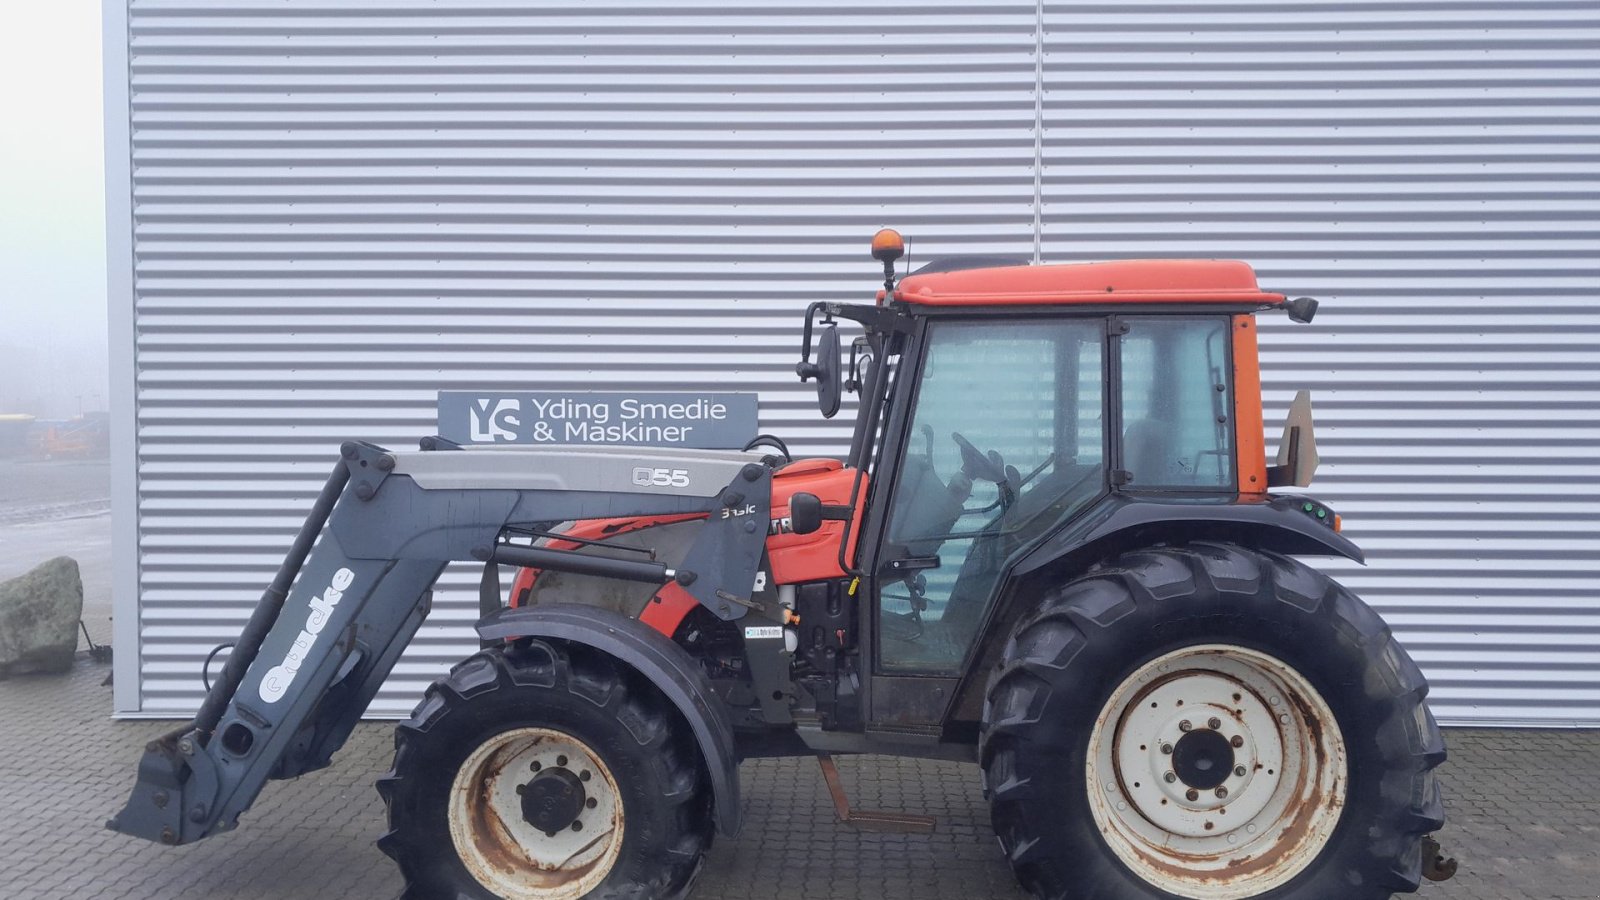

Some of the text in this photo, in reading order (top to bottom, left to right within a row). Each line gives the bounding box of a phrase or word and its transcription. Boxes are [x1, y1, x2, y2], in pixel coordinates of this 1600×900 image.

[470, 399, 520, 441] YS
[532, 399, 726, 423] Yding Smedie
[533, 421, 692, 441] & Maskiner
[632, 467, 690, 487] Q55
[259, 567, 355, 703] Quicke
